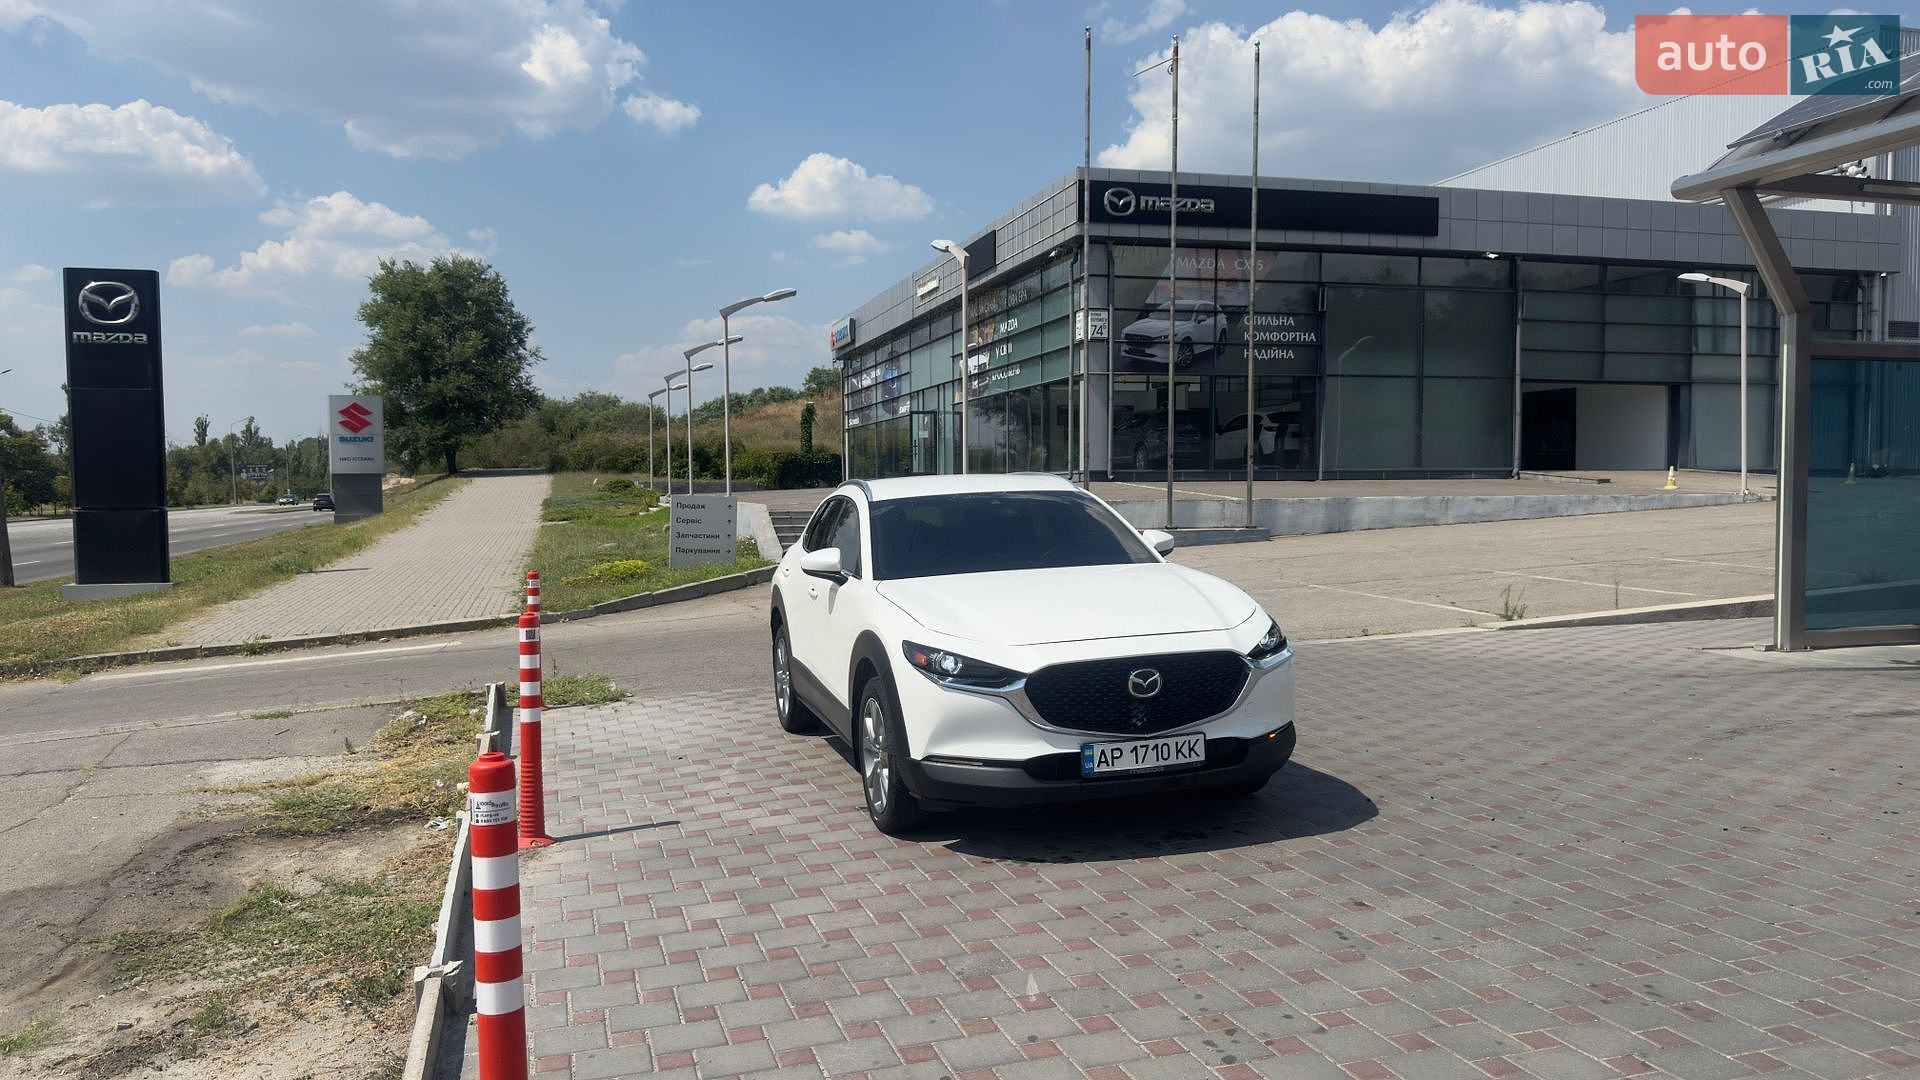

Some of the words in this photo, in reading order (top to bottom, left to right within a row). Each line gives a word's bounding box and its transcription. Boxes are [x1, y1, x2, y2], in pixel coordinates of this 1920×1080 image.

[1140, 195, 1215, 213] mazda
[1177, 256, 1225, 270] MAZDA
[1234, 259, 1264, 271] CX5
[1244, 315, 1295, 326] СТИЛЬНА
[72, 331, 148, 344] mazda
[1244, 331, 1317, 342] КОМФОРТНА
[1244, 346, 1295, 360] НАДІЙНА
[676, 501, 705, 510] Продаж
[675, 516, 702, 525] Сервіс
[675, 531, 720, 539] Запчастини
[1096, 747, 1123, 768] AP
[1130, 743, 1171, 765] 1710
[1175, 738, 1200, 760] KK
